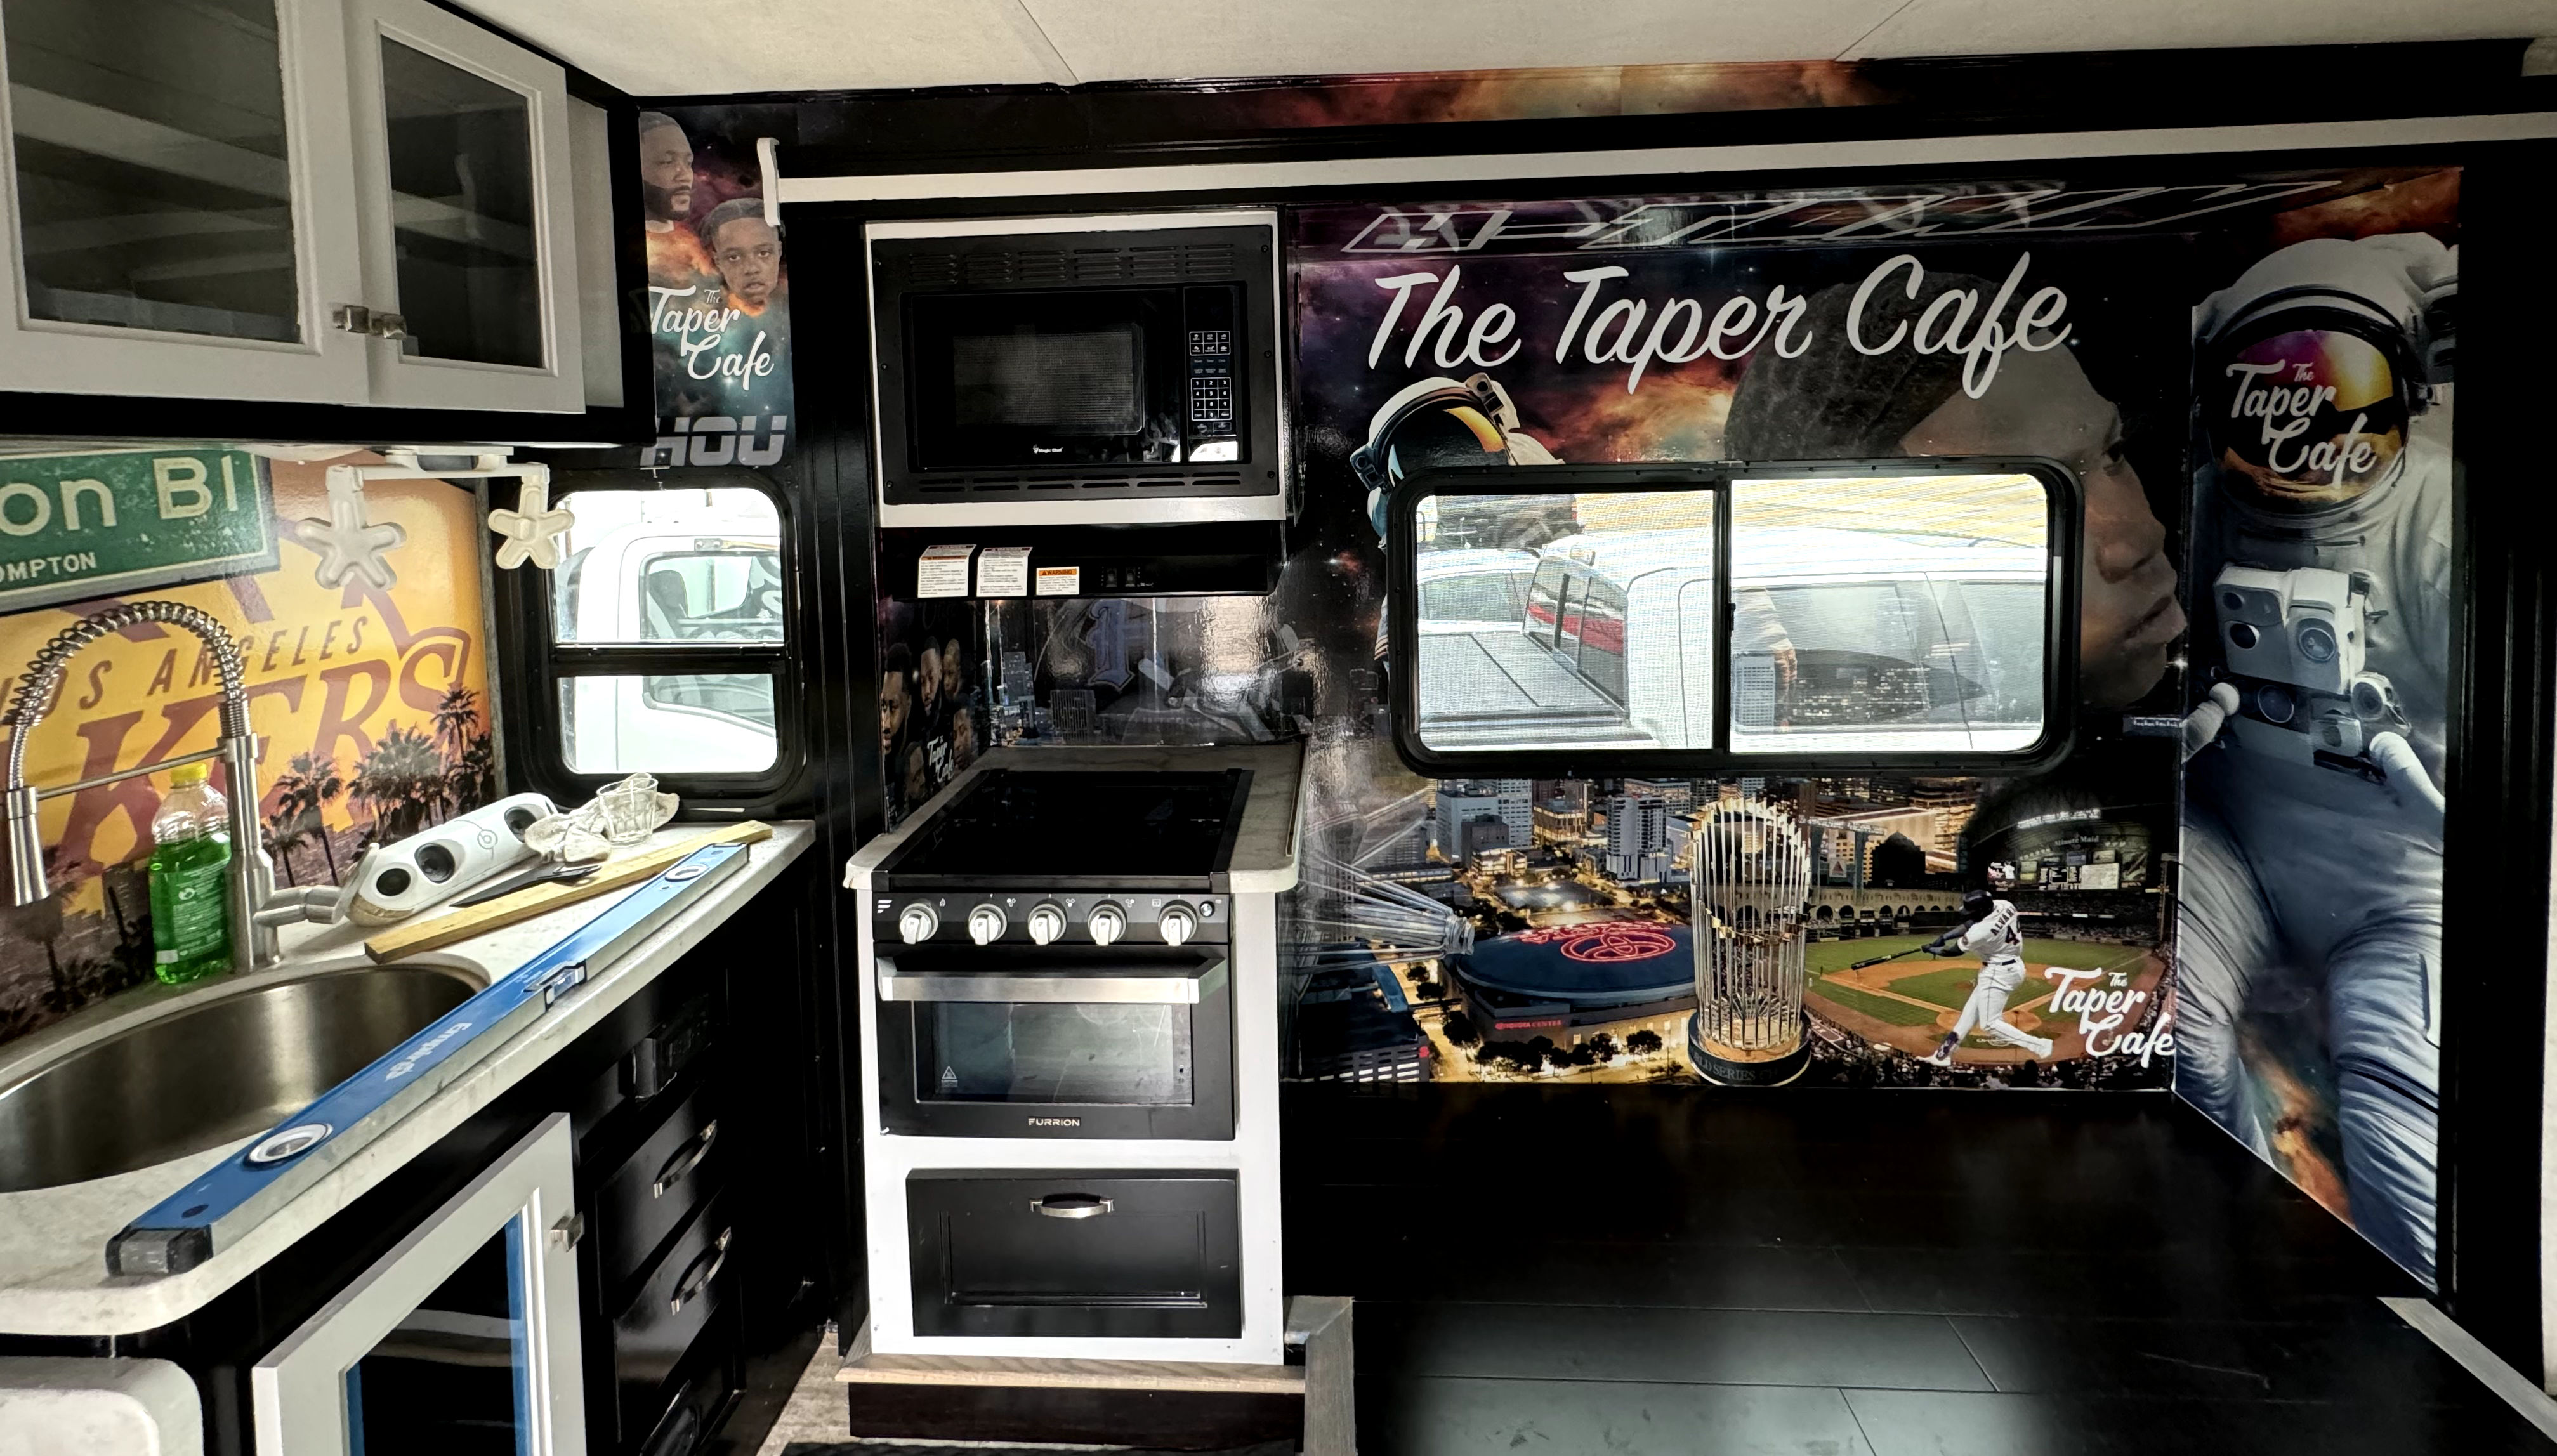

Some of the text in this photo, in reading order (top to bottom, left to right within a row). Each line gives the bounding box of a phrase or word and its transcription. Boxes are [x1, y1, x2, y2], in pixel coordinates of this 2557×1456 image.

[649, 285, 741, 357] Taper
[704, 289, 721, 305] The
[1368, 251, 2073, 400] The Taper Cafe
[685, 330, 774, 391] Cafe
[2292, 362, 2314, 382] The
[2225, 358, 2336, 445] Taper
[640, 415, 787, 466] HOU
[2268, 412, 2377, 490] Cafe
[2044, 967, 2146, 1035] Taper
[2108, 971, 2128, 987] The
[2085, 1011, 2176, 1068] Cafe
[1028, 1118, 1081, 1127] FURRION
